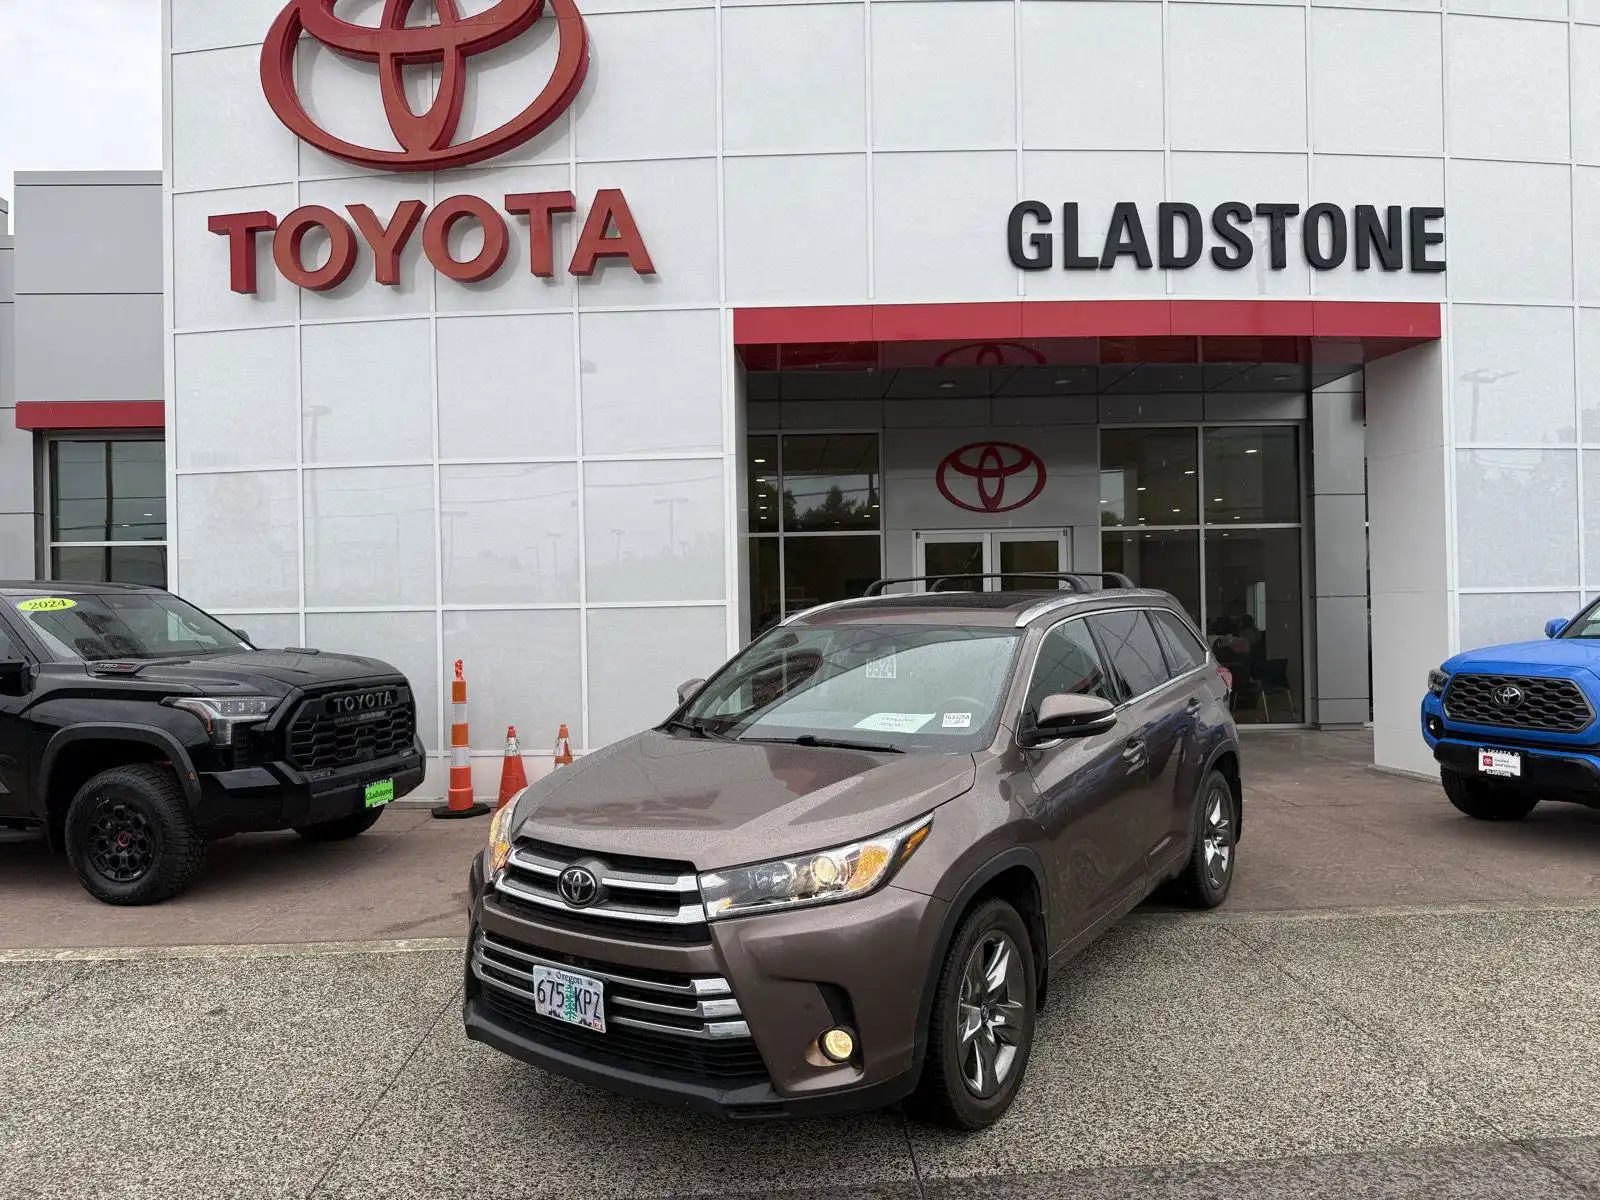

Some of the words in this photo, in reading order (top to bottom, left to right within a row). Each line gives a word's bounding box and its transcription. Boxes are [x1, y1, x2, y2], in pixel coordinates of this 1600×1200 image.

[207, 188, 656, 295] TOYOTA
[1007, 200, 1447, 273] GLADSTONE
[29, 599, 67, 610] 2024
[333, 690, 393, 713] TOYOTA
[556, 971, 583, 985] Oregon
[537, 979, 565, 1008] 675
[575, 986, 601, 1020] KPZ
